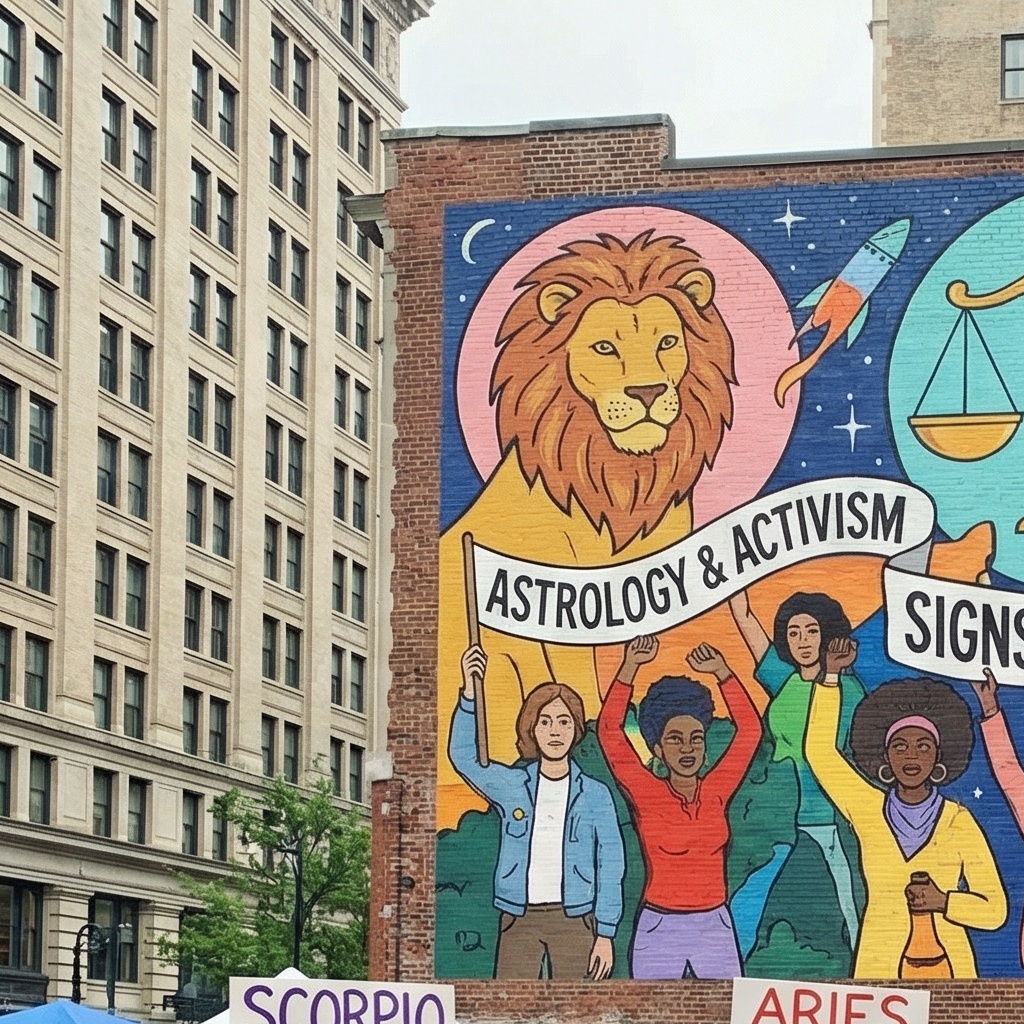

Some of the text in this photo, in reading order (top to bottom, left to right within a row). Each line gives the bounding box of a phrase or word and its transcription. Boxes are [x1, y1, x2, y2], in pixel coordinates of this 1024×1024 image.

[485, 491, 907, 629] ASTROLOGY & ACTIVISM
